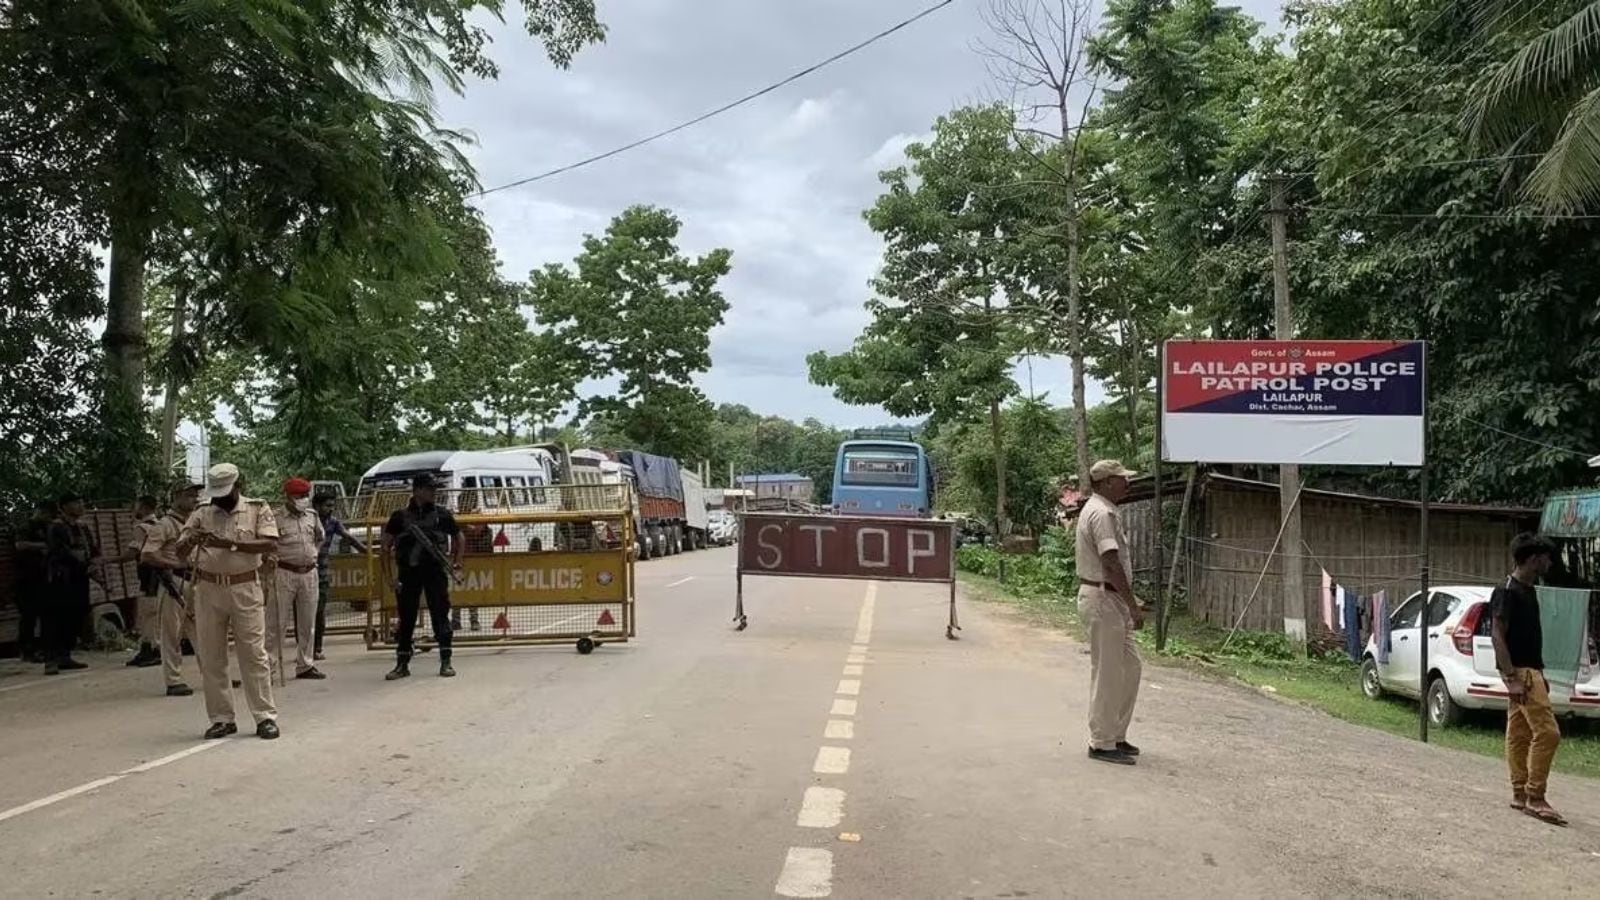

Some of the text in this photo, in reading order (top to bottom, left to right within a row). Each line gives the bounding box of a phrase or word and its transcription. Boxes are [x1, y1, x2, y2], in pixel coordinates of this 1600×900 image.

[1251, 349, 1336, 357] Govt. of Assam
[1173, 362, 1415, 375] LAILAPUR POLICE
[1201, 377, 1386, 391] PATROL POST
[1263, 393, 1323, 402] LAILAPUR
[1249, 403, 1270, 411] Dist.
[1307, 403, 1337, 411] Assam
[757, 524, 936, 574] STOP
[511, 568, 583, 590] POLICE
